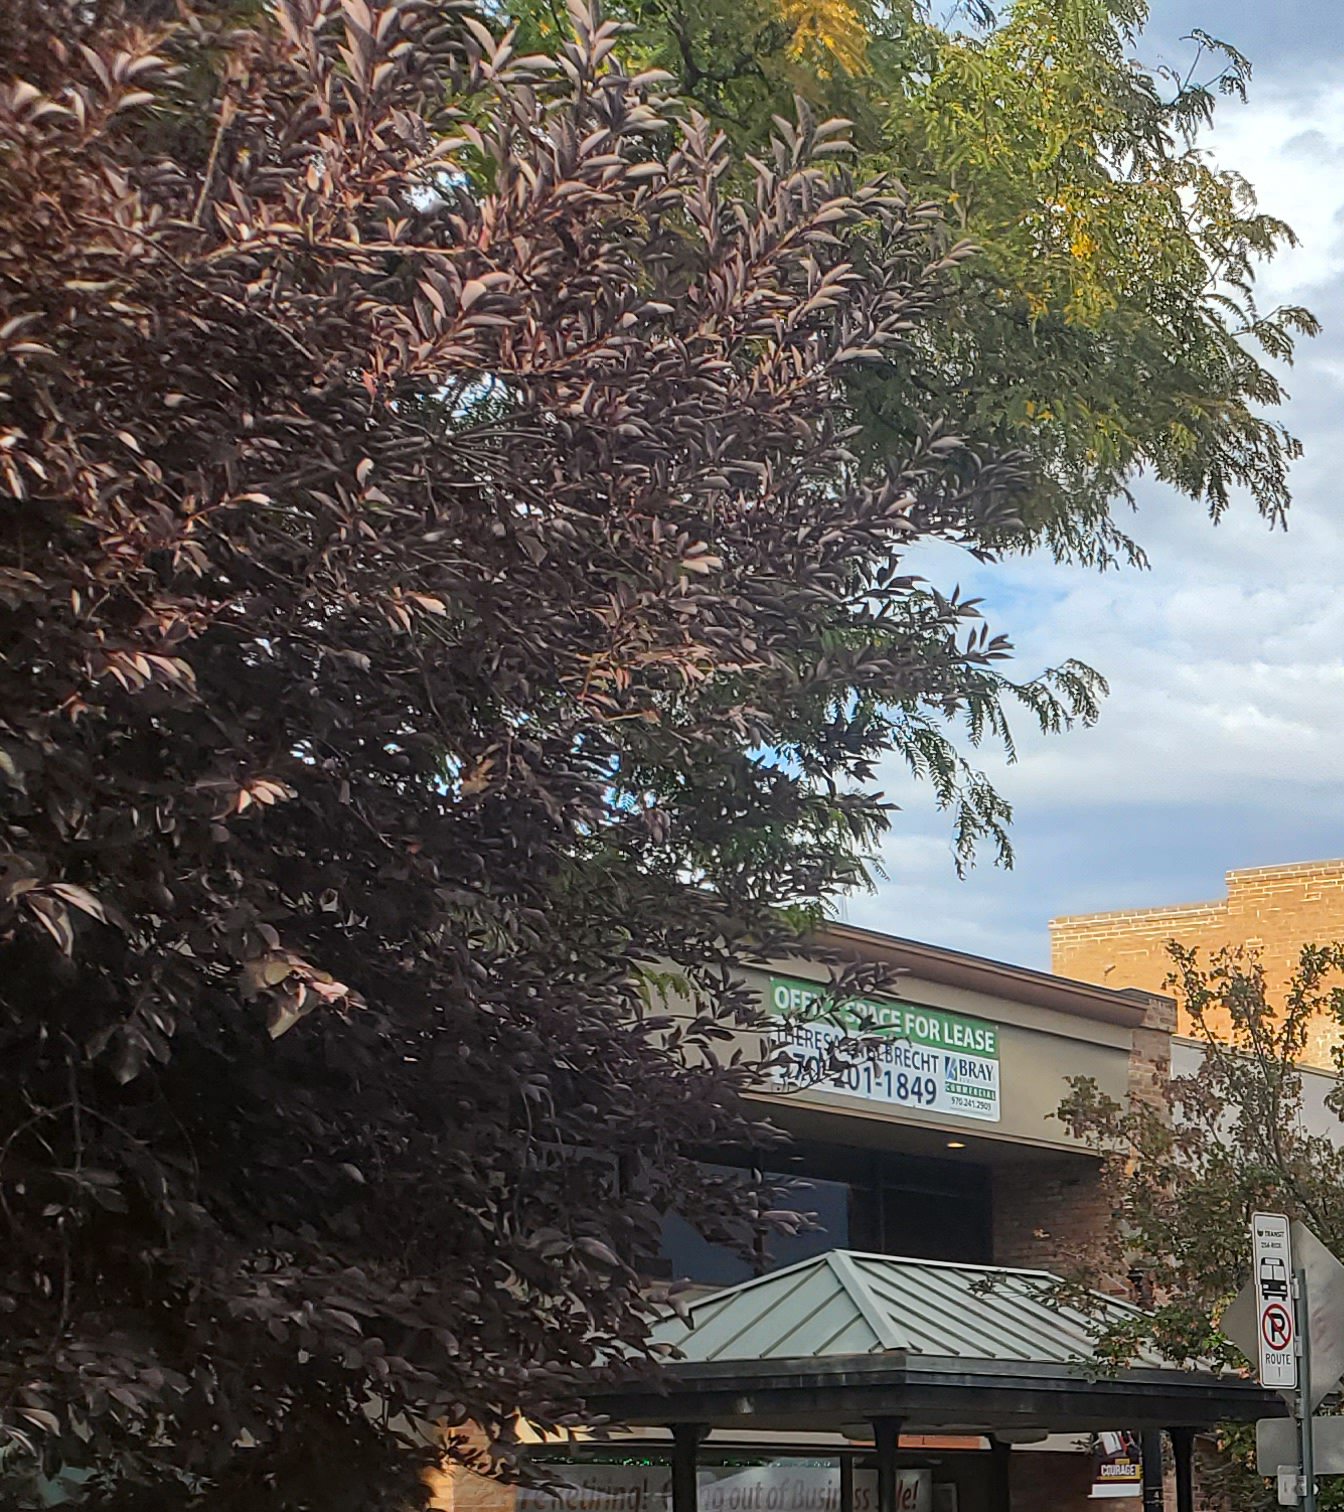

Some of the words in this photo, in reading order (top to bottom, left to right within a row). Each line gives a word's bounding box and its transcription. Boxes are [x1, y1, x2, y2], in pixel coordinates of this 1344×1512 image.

[774, 985, 840, 1018] OFFI
[905, 1012, 941, 1042] FOR
[944, 1021, 995, 1053] LEASE
[958, 1058, 994, 1081] BRAY
[1265, 1353, 1291, 1366] ROUTE
[1101, 1464, 1136, 1477] COURAGE
[729, 1481, 762, 1510] out
[765, 1477, 790, 1510] of
